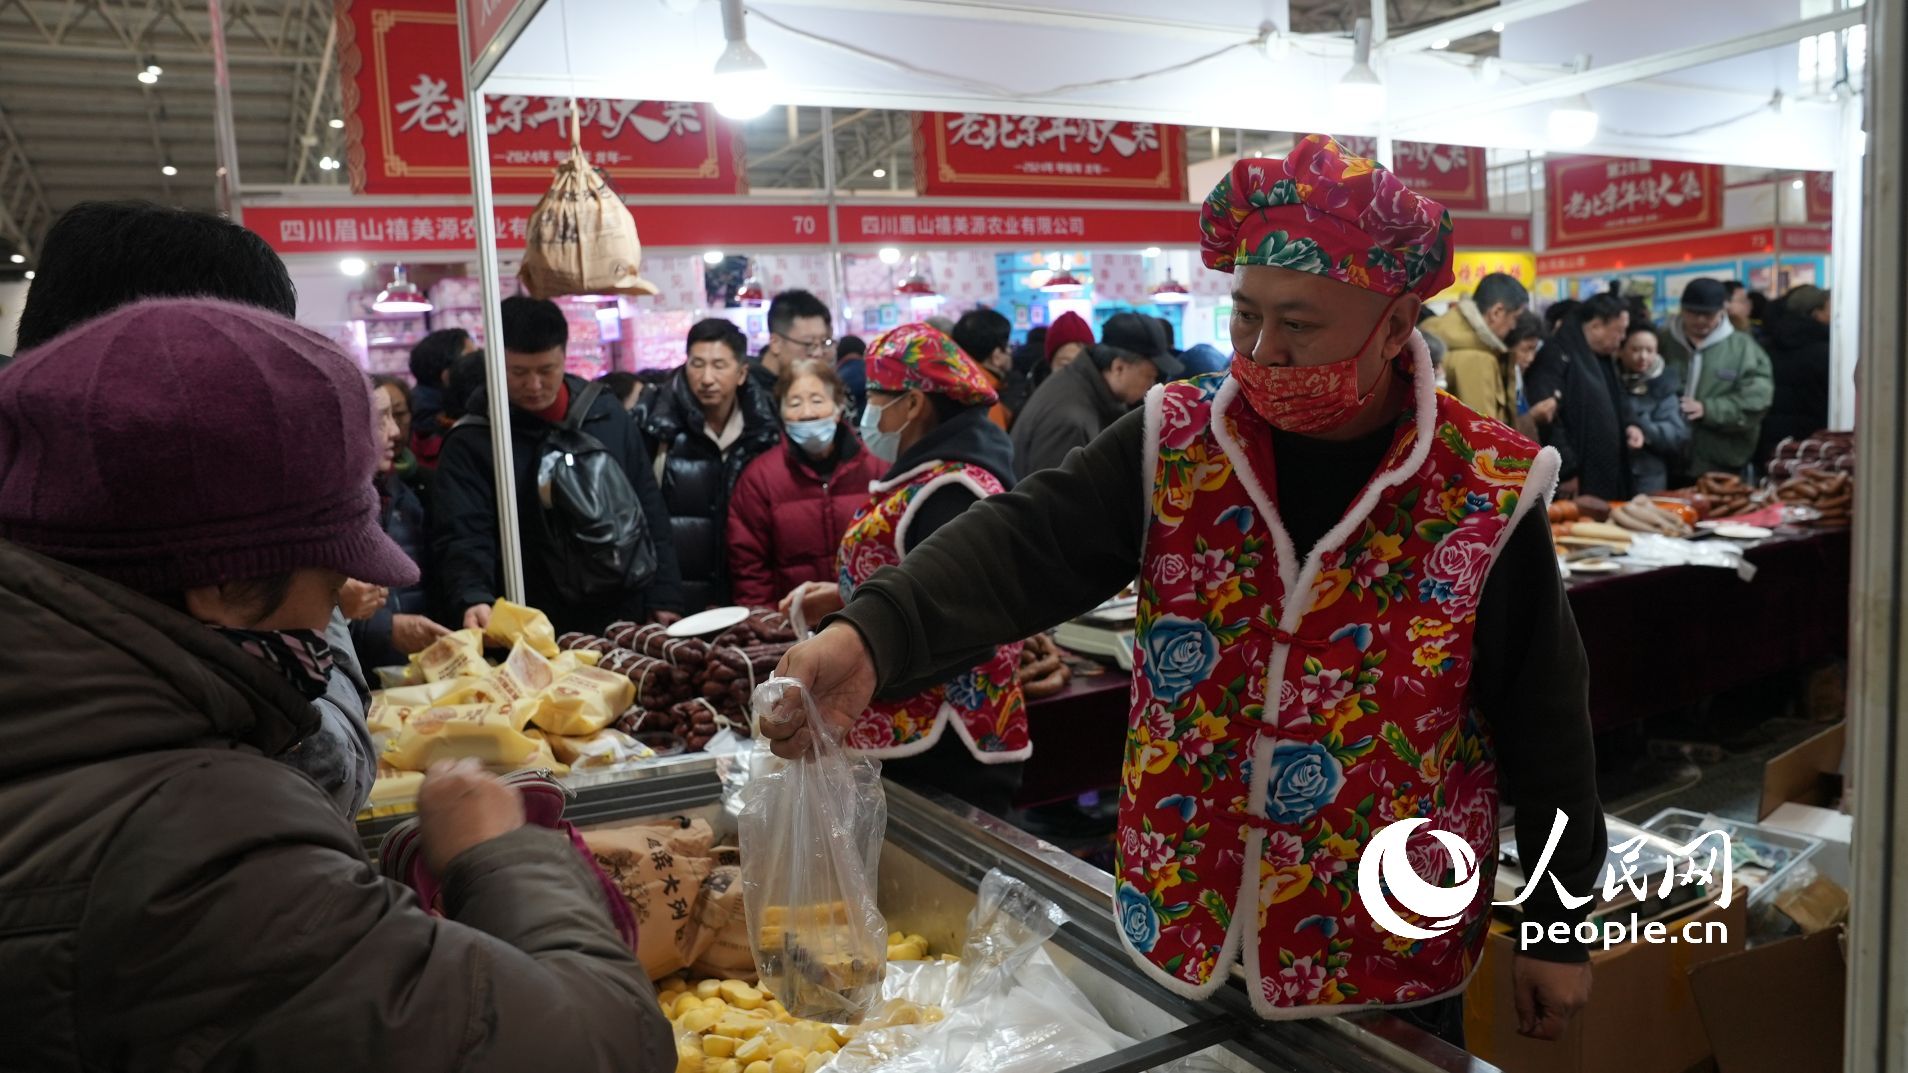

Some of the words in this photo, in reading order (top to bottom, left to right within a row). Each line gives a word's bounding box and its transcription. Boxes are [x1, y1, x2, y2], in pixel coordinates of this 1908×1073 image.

[793, 216, 815, 234] 70
[861, 215, 1085, 236] 四川眉山禧美源农业有限公司
